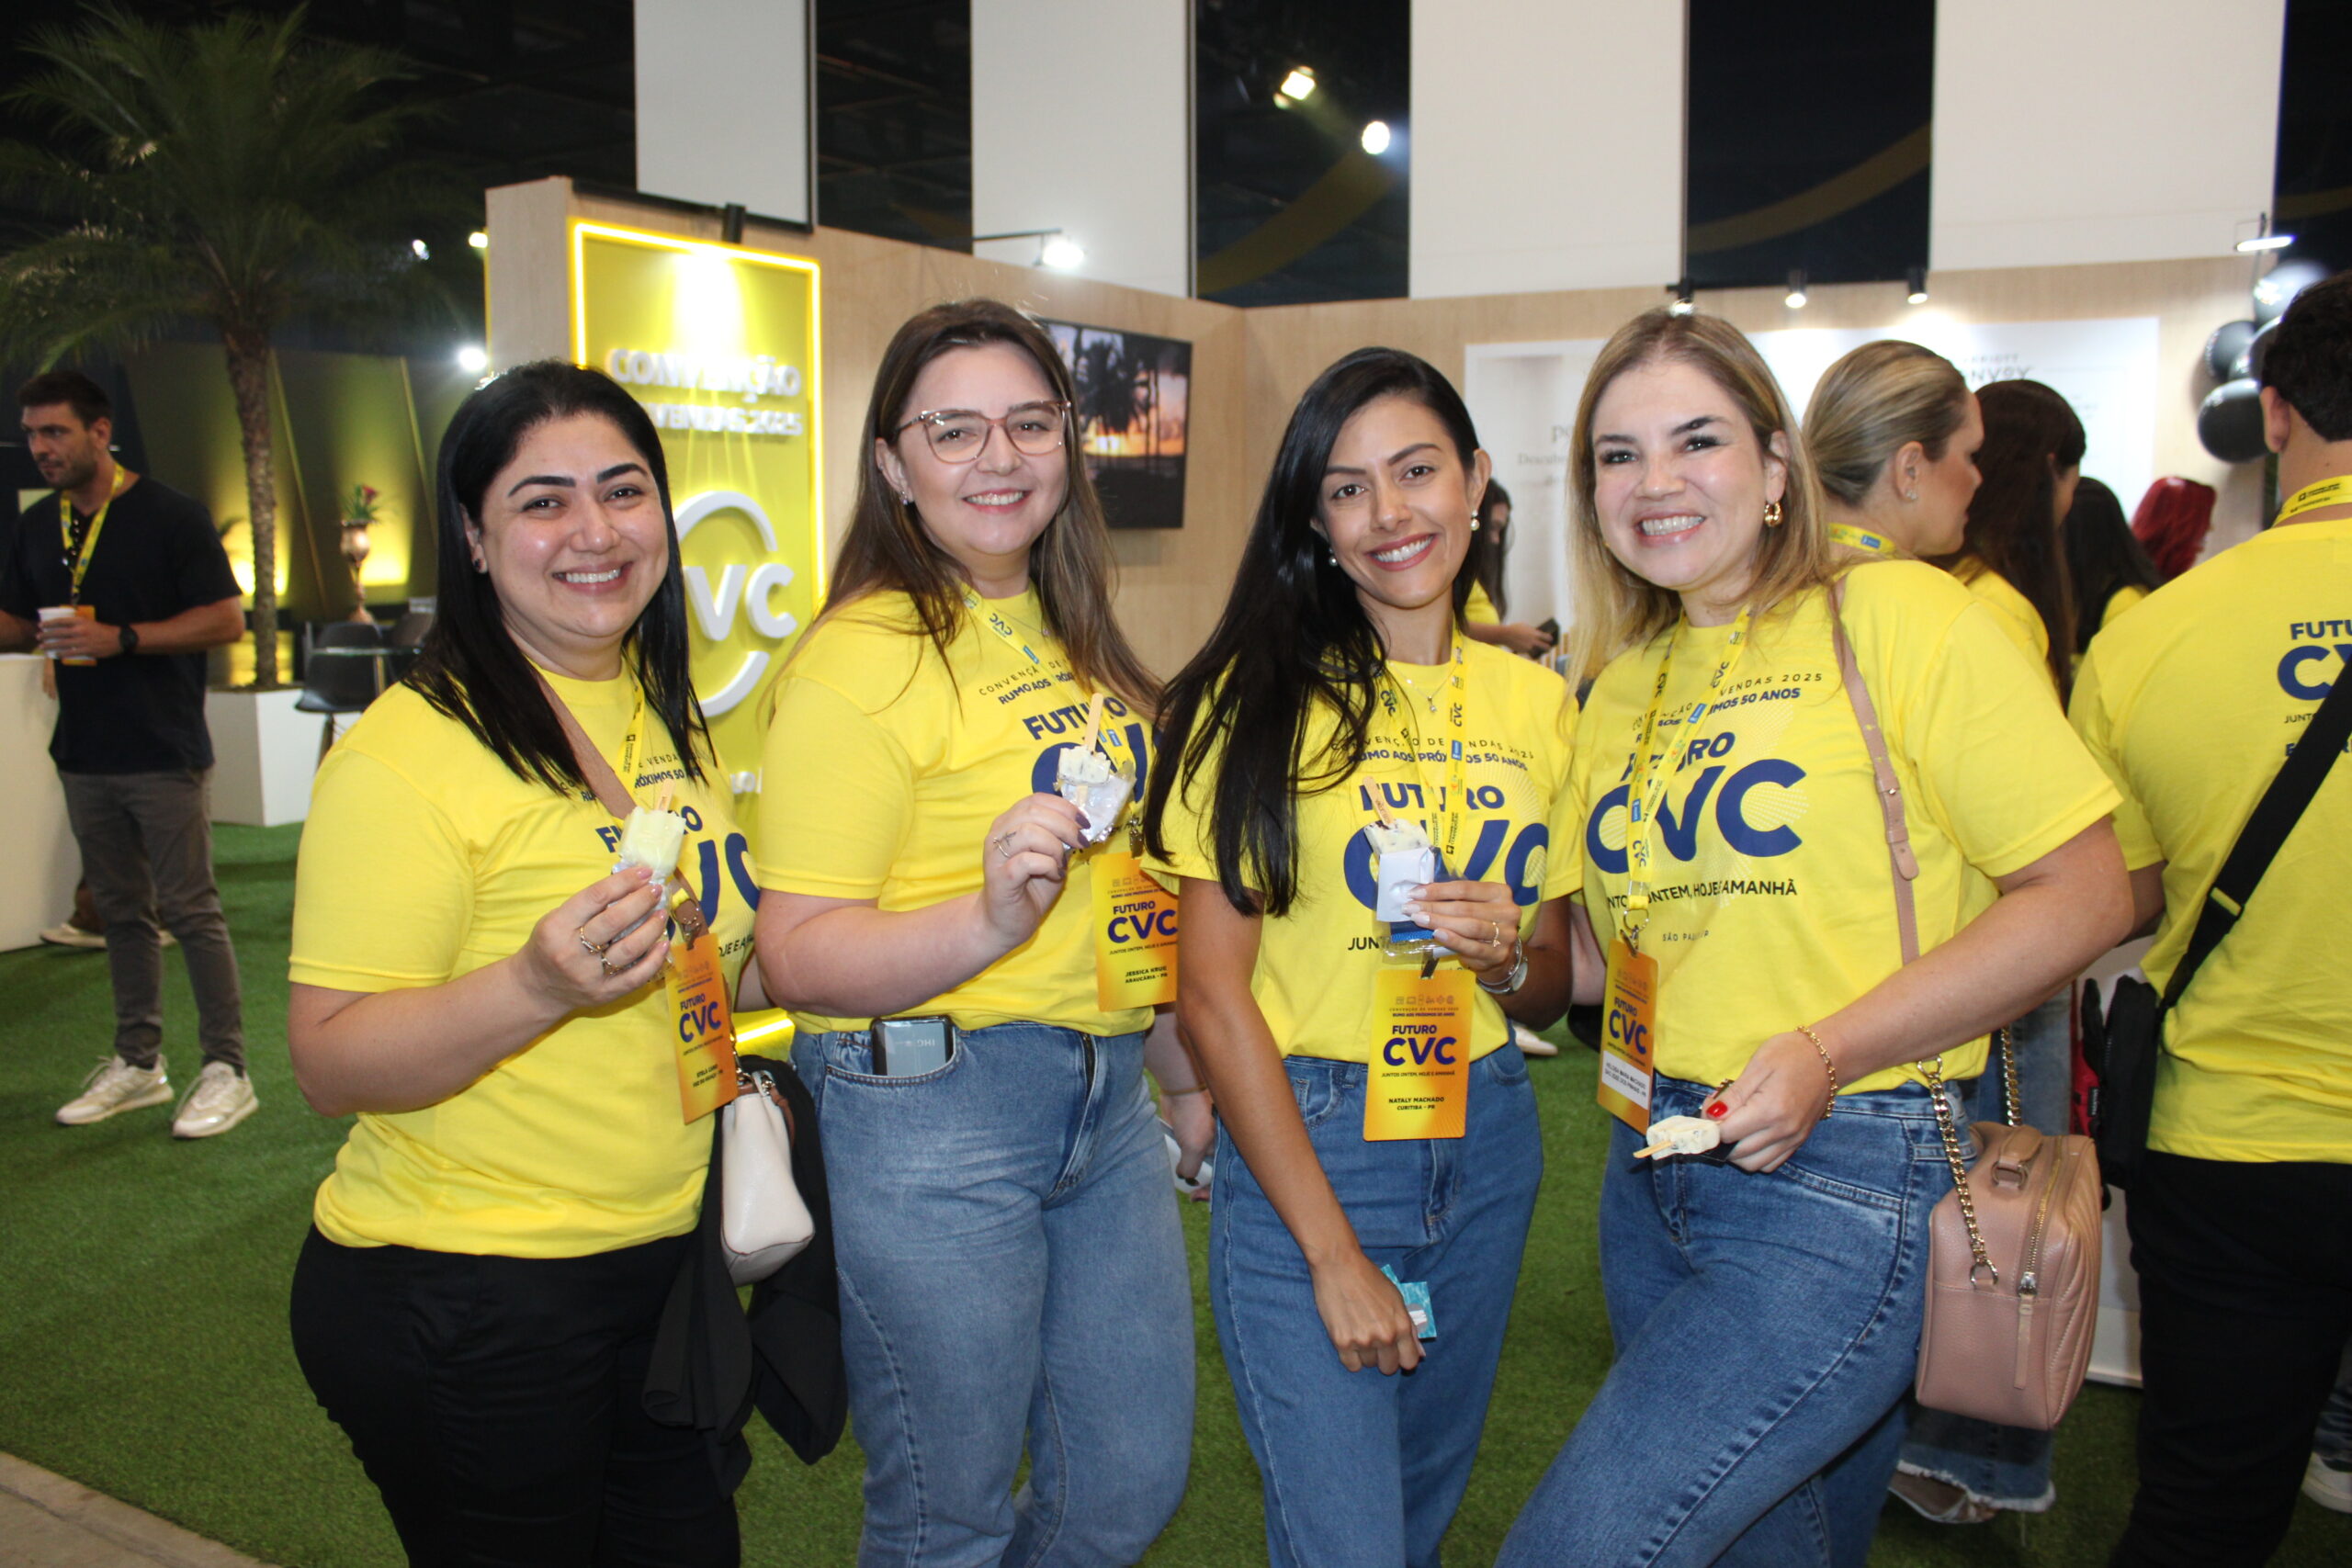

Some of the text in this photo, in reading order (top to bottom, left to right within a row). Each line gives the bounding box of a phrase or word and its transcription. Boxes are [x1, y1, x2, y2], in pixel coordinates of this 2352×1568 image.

[683, 562, 797, 641] VC
[998, 683, 1031, 705] RUMO
[1031, 678, 1052, 691] AOS
[1720, 676, 1772, 696] VENDAS
[1781, 672, 1823, 682] 2025
[1741, 693, 1758, 705] 50
[1758, 687, 1801, 703] ANOS
[1022, 696, 1127, 740] FUTUO
[2284, 713, 2317, 725] JUNT
[1428, 738, 1445, 746] DE
[1468, 739, 1503, 750] NDAS
[647, 754, 678, 765] VENDA
[1350, 750, 1390, 761] UMO
[1419, 750, 1482, 763] PRÓXOS
[1485, 752, 1499, 762] 50
[635, 771, 673, 788] RÓXIMOS
[673, 769, 684, 780] 50
[1721, 879, 1798, 897] AMANHÃ
[1113, 900, 1156, 915] FUTURO
[1107, 908, 1179, 943] CVC
[679, 1001, 721, 1043] CVC
[1392, 1025, 1437, 1034] FUTURO
[1609, 1009, 1647, 1055] CVC
[1383, 1036, 1457, 1066] CVC
